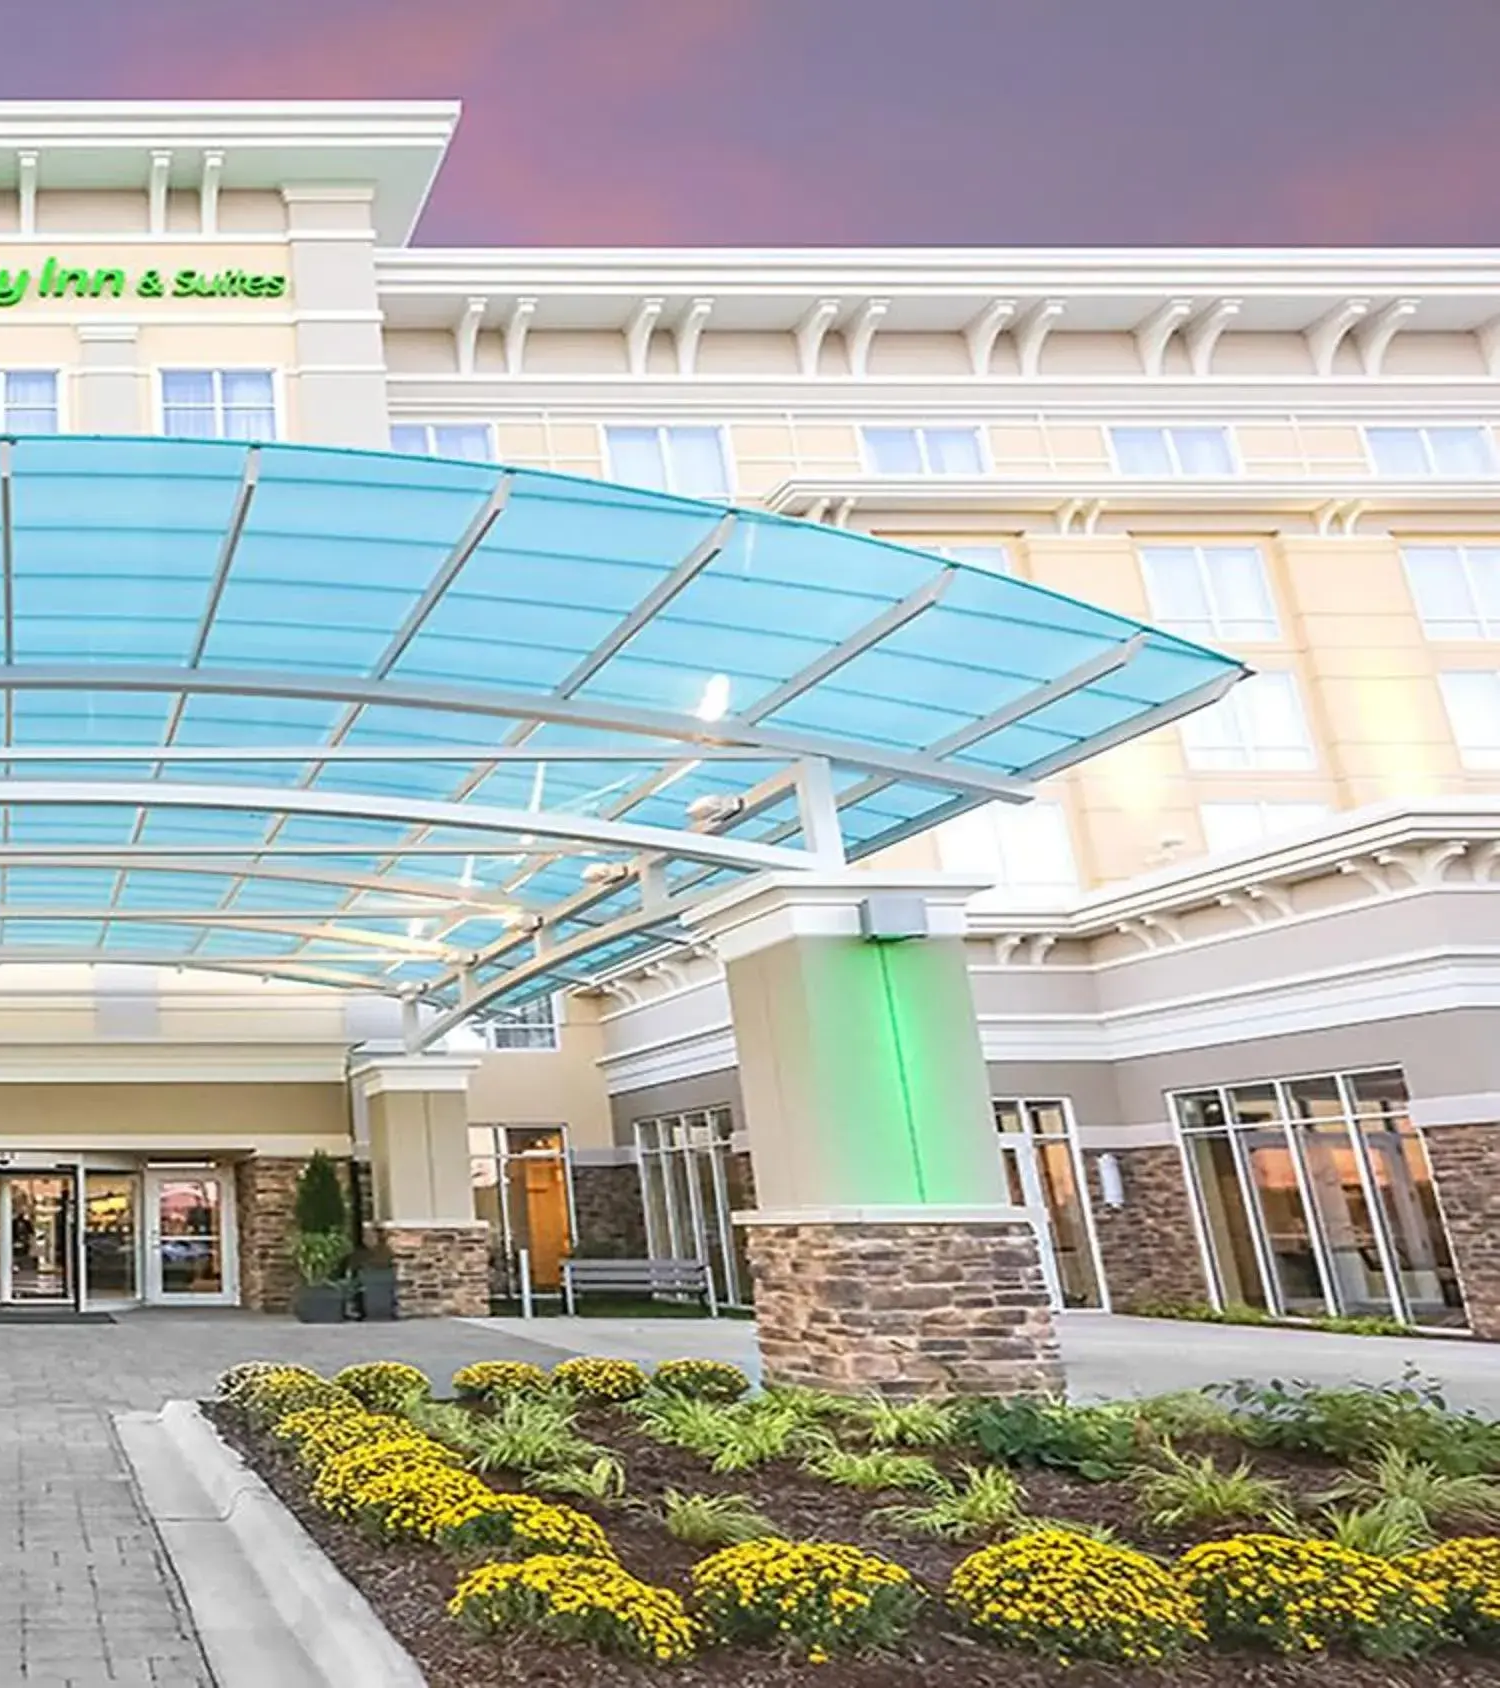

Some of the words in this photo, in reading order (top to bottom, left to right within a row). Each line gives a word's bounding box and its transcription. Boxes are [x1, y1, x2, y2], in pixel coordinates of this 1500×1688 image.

[38, 257, 125, 297] Inn
[137, 270, 163, 298] &
[171, 269, 286, 298] Suites
